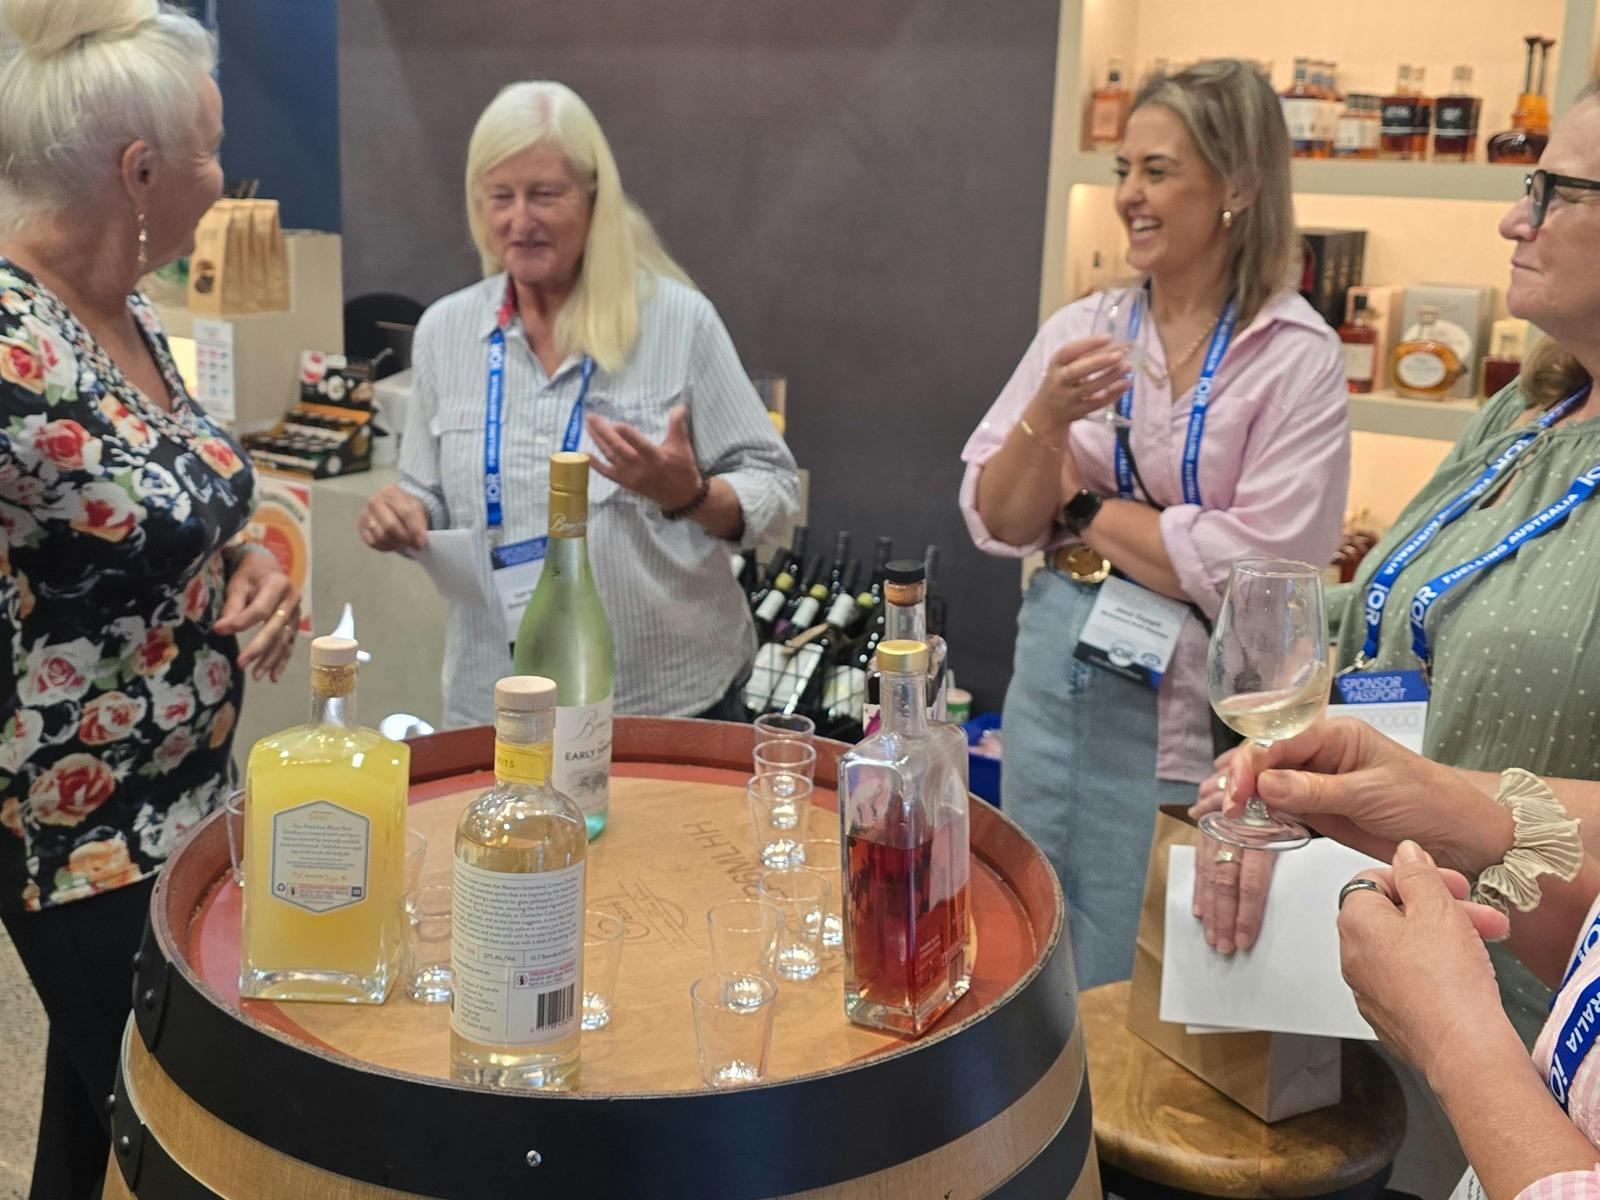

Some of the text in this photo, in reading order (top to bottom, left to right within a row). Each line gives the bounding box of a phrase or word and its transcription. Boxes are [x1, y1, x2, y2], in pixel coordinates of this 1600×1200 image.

[1441, 494, 1579, 584] FUELLING AUSTRALIA
[1365, 583, 1389, 626] IOR
[1410, 585, 1438, 628] IOR
[1342, 676, 1402, 690] SPONSOR
[1345, 688, 1406, 703] PASSPORT
[565, 748, 596, 761] EARLY
